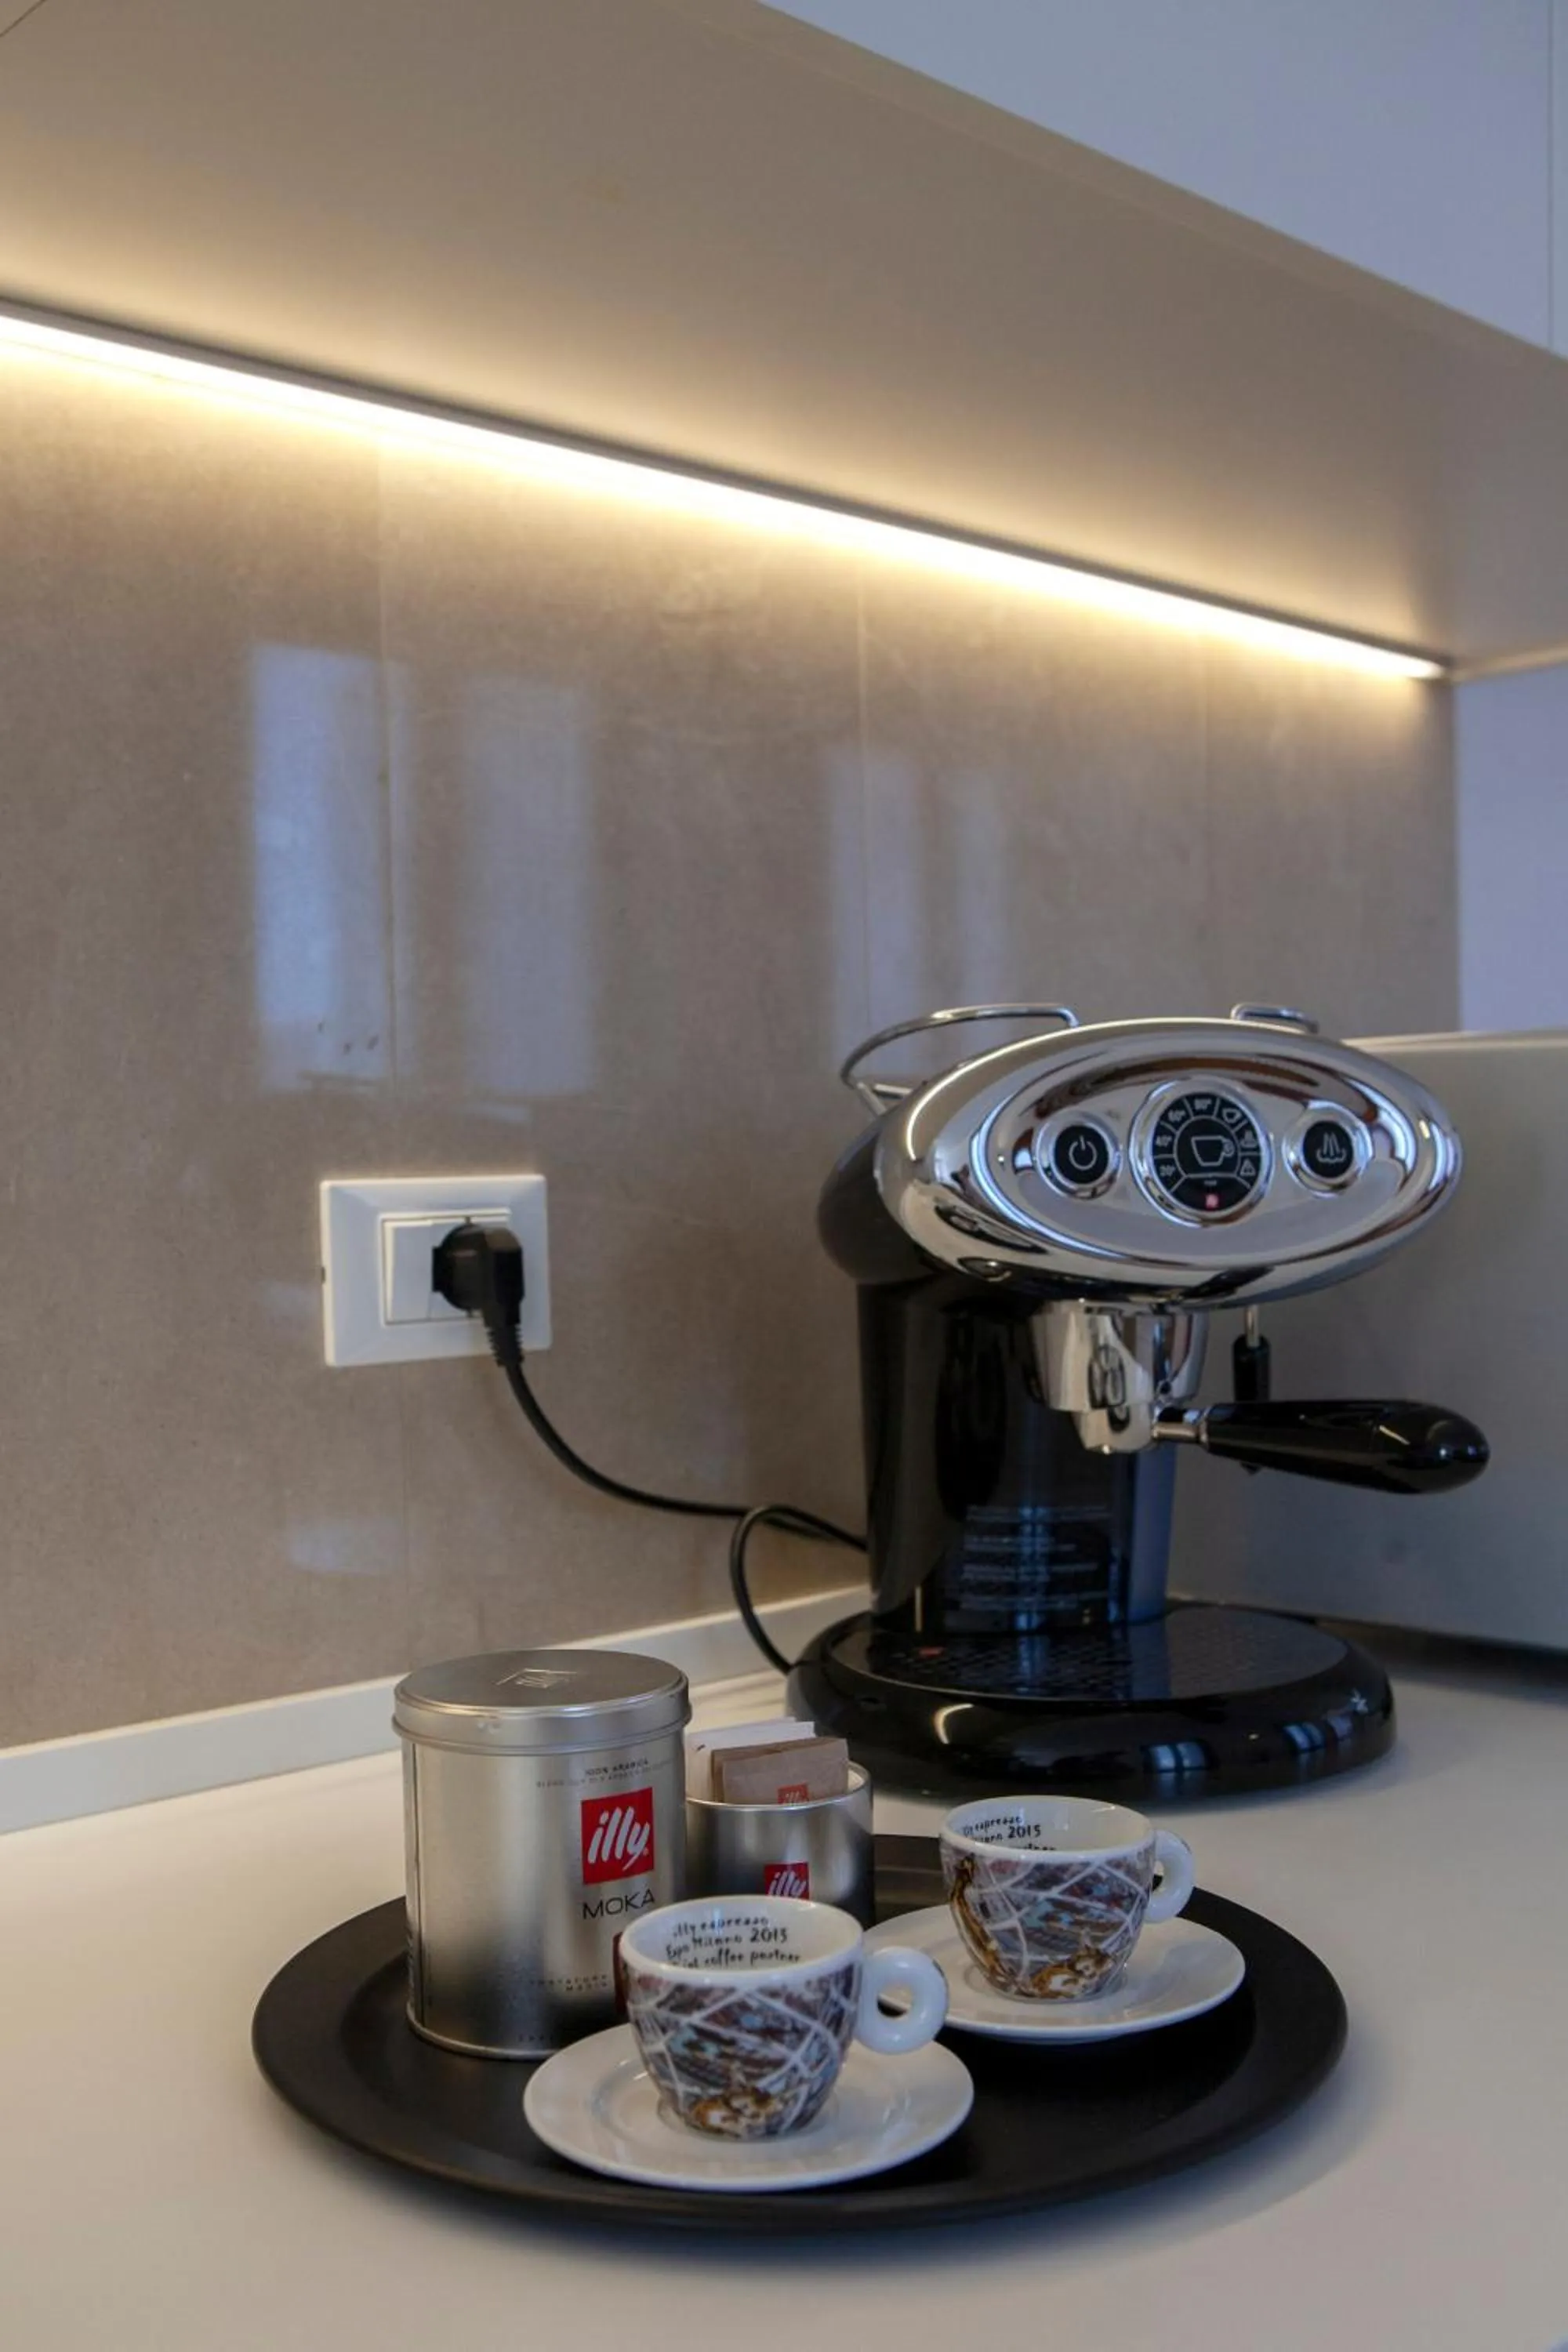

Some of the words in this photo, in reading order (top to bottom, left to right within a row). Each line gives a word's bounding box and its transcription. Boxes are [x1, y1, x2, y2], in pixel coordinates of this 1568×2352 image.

[587, 1806, 650, 1871] illy
[1007, 1824, 1041, 1839] 2015
[768, 1871, 807, 1898] illy
[583, 1888, 656, 1921] MOKA
[700, 1916, 769, 1936] espresso
[666, 1944, 690, 1961] Expo
[750, 1926, 788, 1944] 2015
[704, 1947, 744, 1967] coffee
[750, 1947, 800, 1967] partner
